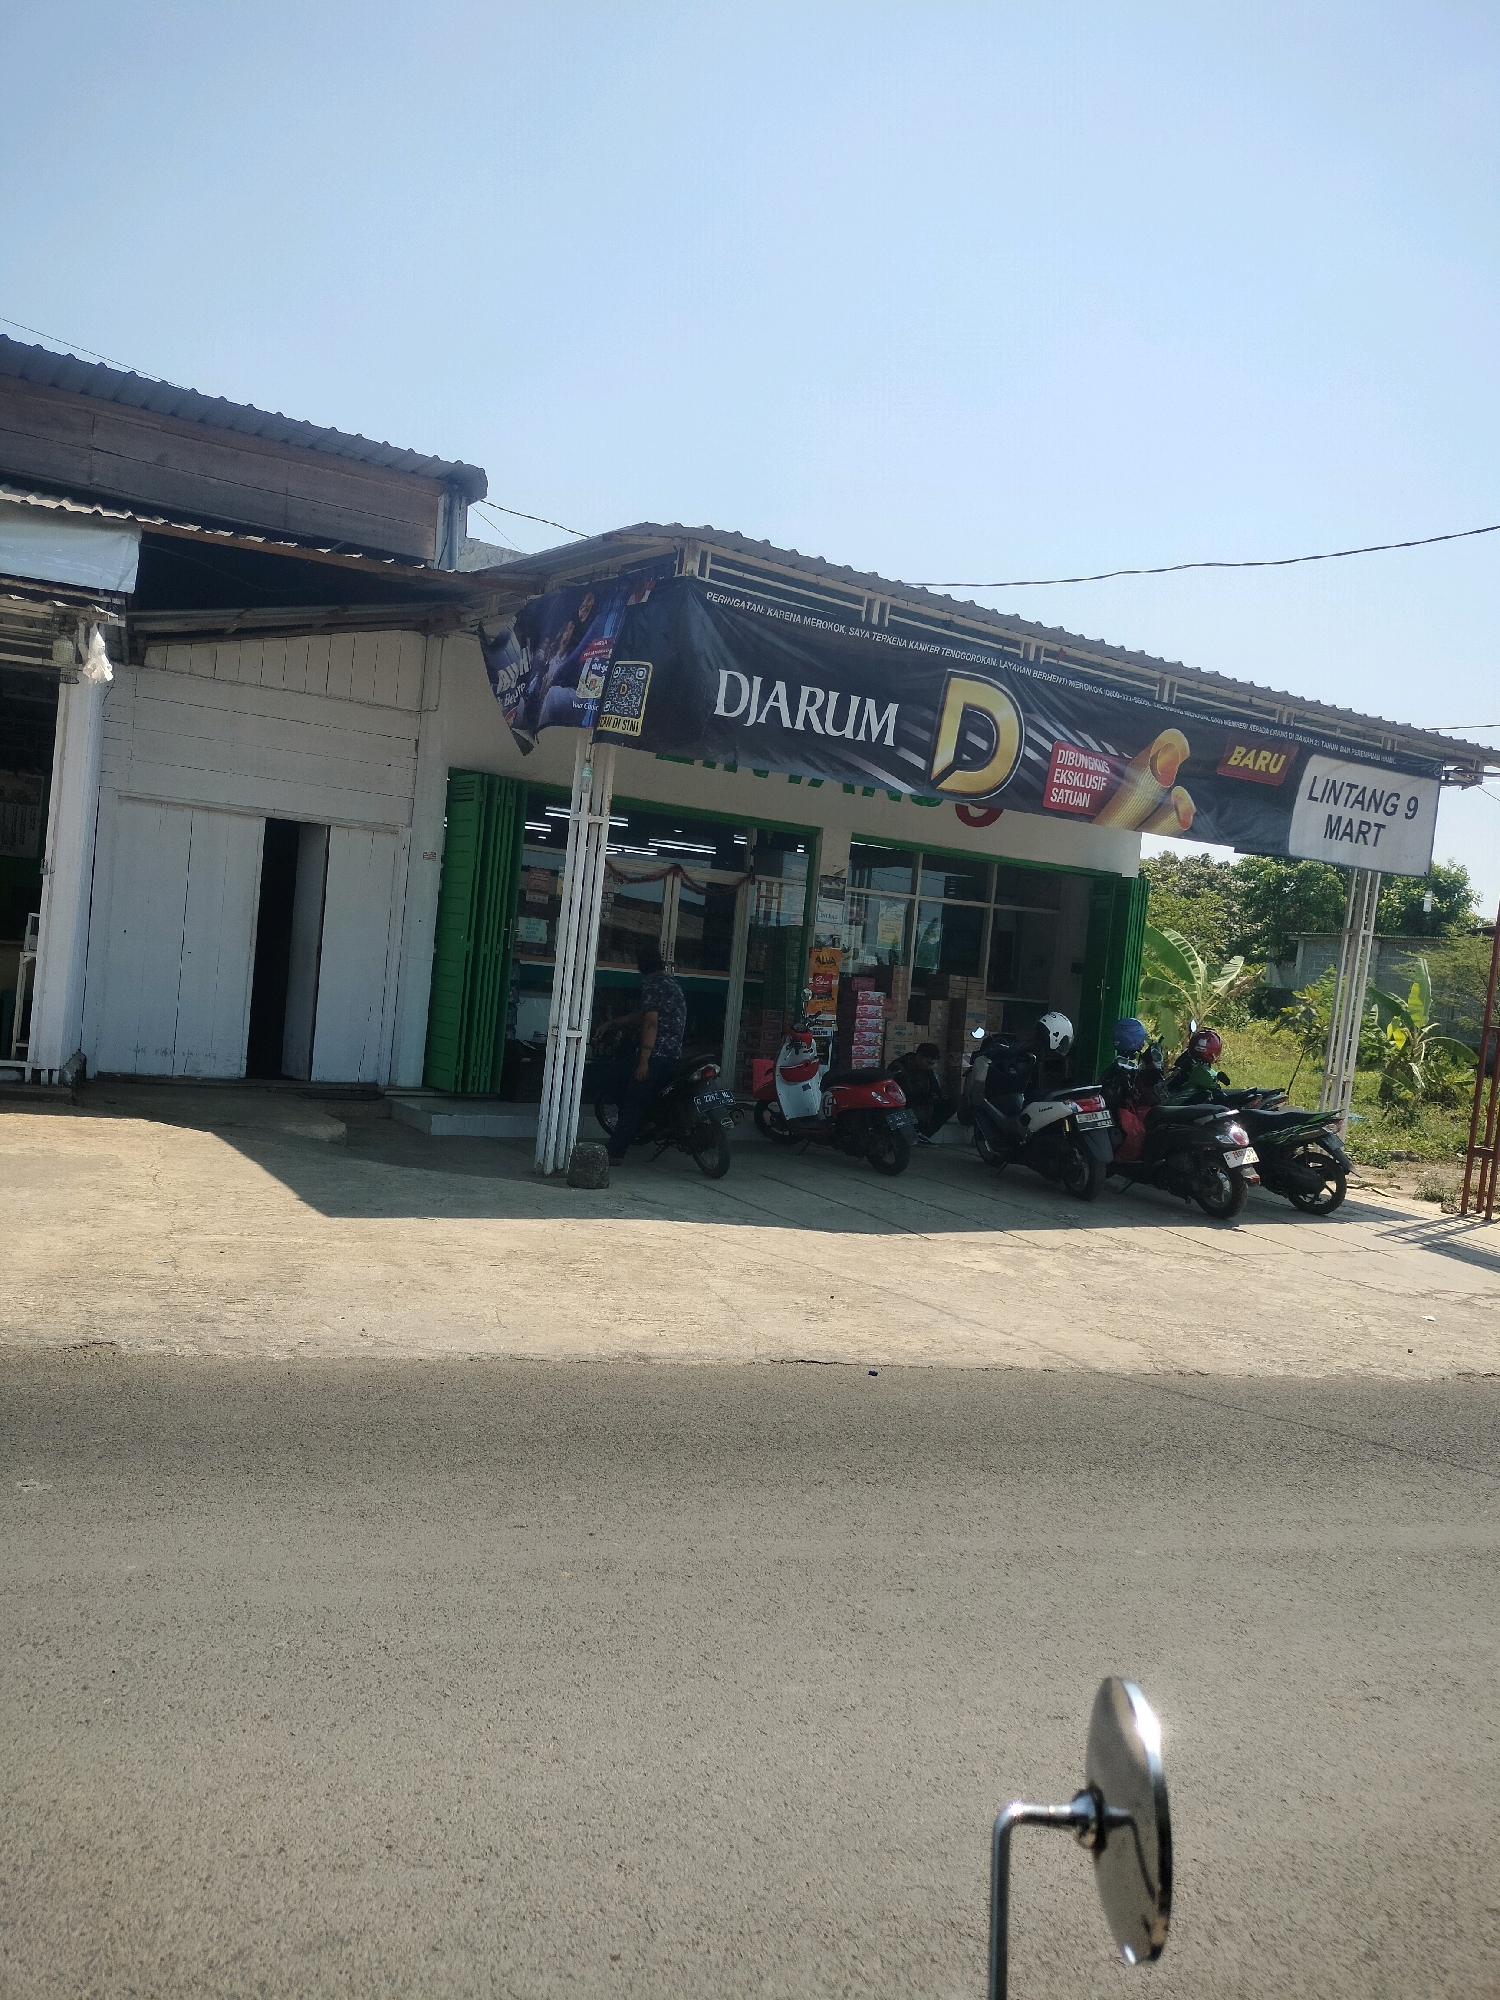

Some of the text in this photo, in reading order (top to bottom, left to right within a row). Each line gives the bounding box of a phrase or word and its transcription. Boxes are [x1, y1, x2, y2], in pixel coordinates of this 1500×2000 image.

[706, 591, 765, 614] PERINGATAN:
[766, 607, 801, 624] KARENA
[803, 616, 847, 635] MEROKOK,
[848, 627, 870, 639] SAYA
[872, 631, 907, 648] TERKENA
[908, 640, 940, 655] KANKER
[941, 647, 998, 666] TENGGOROKAN.
[999, 659, 1032, 676] LAYANAN
[1068, 679, 1103, 695] MEROKOK
[1321, 741, 1339, 751] TAHUN
[713, 669, 899, 746] DJARUM
[613, 716, 622, 730] DI
[622, 717, 639, 733] SINI
[1056, 749, 1111, 774] DIBUNGKUS
[1227, 745, 1287, 775] BARU
[1053, 768, 1107, 791] EKSKLUSIF
[1050, 787, 1091, 808] SATUAN
[1307, 775, 1419, 820] LINTANG 9
[1323, 813, 1386, 848] MART
